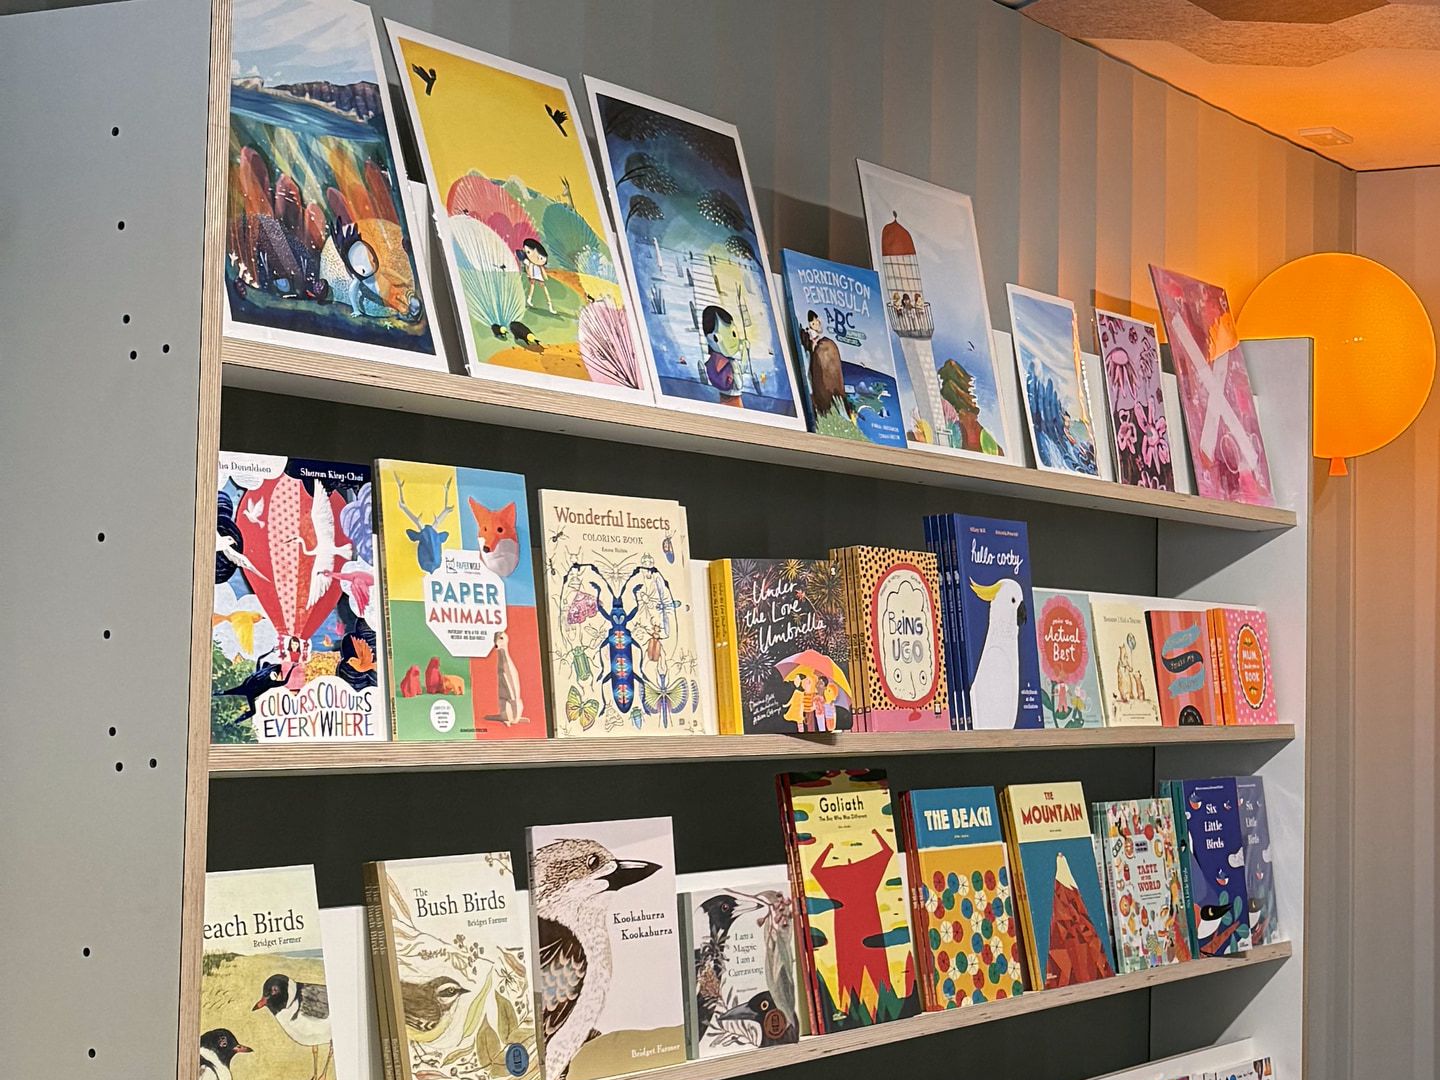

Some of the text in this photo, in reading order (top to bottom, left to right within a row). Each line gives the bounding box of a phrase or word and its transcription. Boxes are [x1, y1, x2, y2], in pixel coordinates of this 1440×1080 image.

[798, 269, 870, 299] MORNINGTON
[803, 286, 869, 317] PENINSULA
[824, 307, 855, 337] ABC
[554, 506, 670, 530] Wonderful Insects
[582, 533, 643, 545] COLORING BOOK
[971, 538, 1023, 574] hello cocky
[431, 581, 499, 605] PAPER
[752, 581, 798, 604] Under
[429, 607, 502, 625] ANIMALS
[745, 600, 802, 628] the Love
[758, 613, 827, 653] Umbrella
[1044, 626, 1080, 644] Actual
[892, 638, 924, 664] UGO
[1053, 643, 1075, 662] Best
[264, 711, 374, 738] EVERYWHERE
[820, 795, 864, 813] Goliath
[1044, 791, 1055, 801] THE
[1021, 803, 1083, 825] MOUNTAIN
[1206, 804, 1218, 814] Six
[924, 806, 993, 831] THE BEACH
[1204, 821, 1223, 832] Little
[1206, 838, 1224, 849] Birds
[1137, 863, 1158, 875] TASTE
[413, 888, 428, 897] The
[1138, 880, 1161, 892] WORLD
[415, 890, 506, 918] Bush Birds
[203, 909, 305, 939] each Birds
[467, 918, 487, 928] Bridget
[613, 910, 665, 925] Kookaburra
[253, 936, 302, 949] Bridget Farmer
[621, 926, 673, 941] Kookaburra
[631, 1043, 680, 1058] Bridget Farmer
